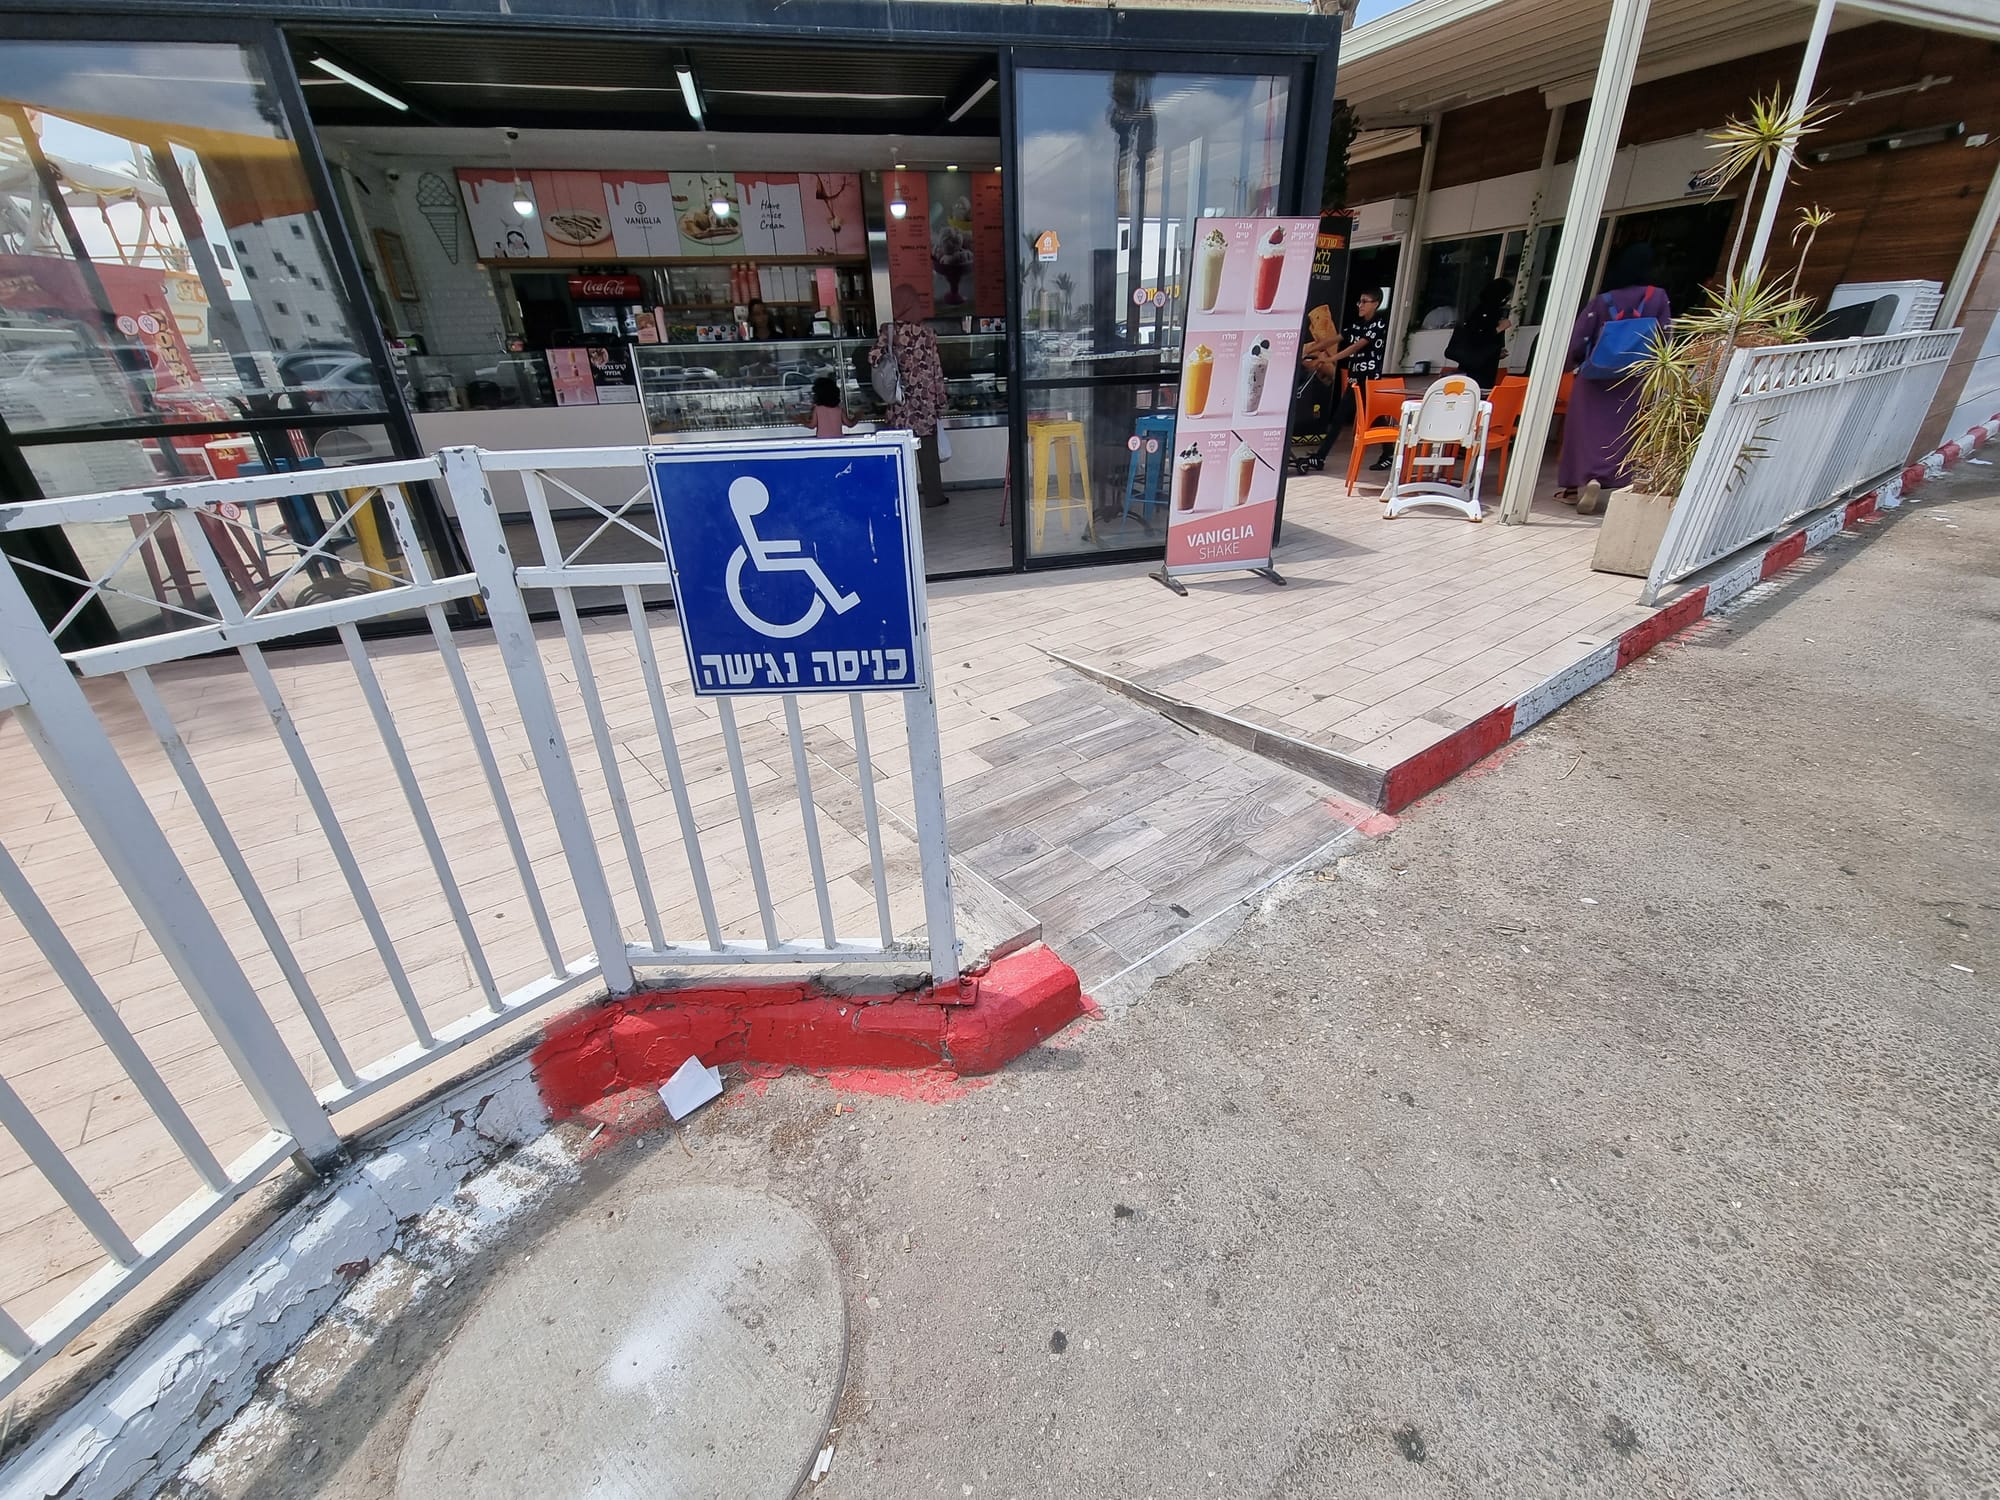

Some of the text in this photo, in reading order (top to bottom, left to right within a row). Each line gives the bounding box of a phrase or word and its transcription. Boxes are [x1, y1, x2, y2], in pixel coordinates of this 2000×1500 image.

[624, 216, 662, 225] VANIGLIA
[760, 219, 785, 230] Cream
[1187, 524, 1255, 548] VANIGLIA
[1199, 541, 1240, 560] SHAKE
[700, 648, 908, 686] כניסה נגישה
